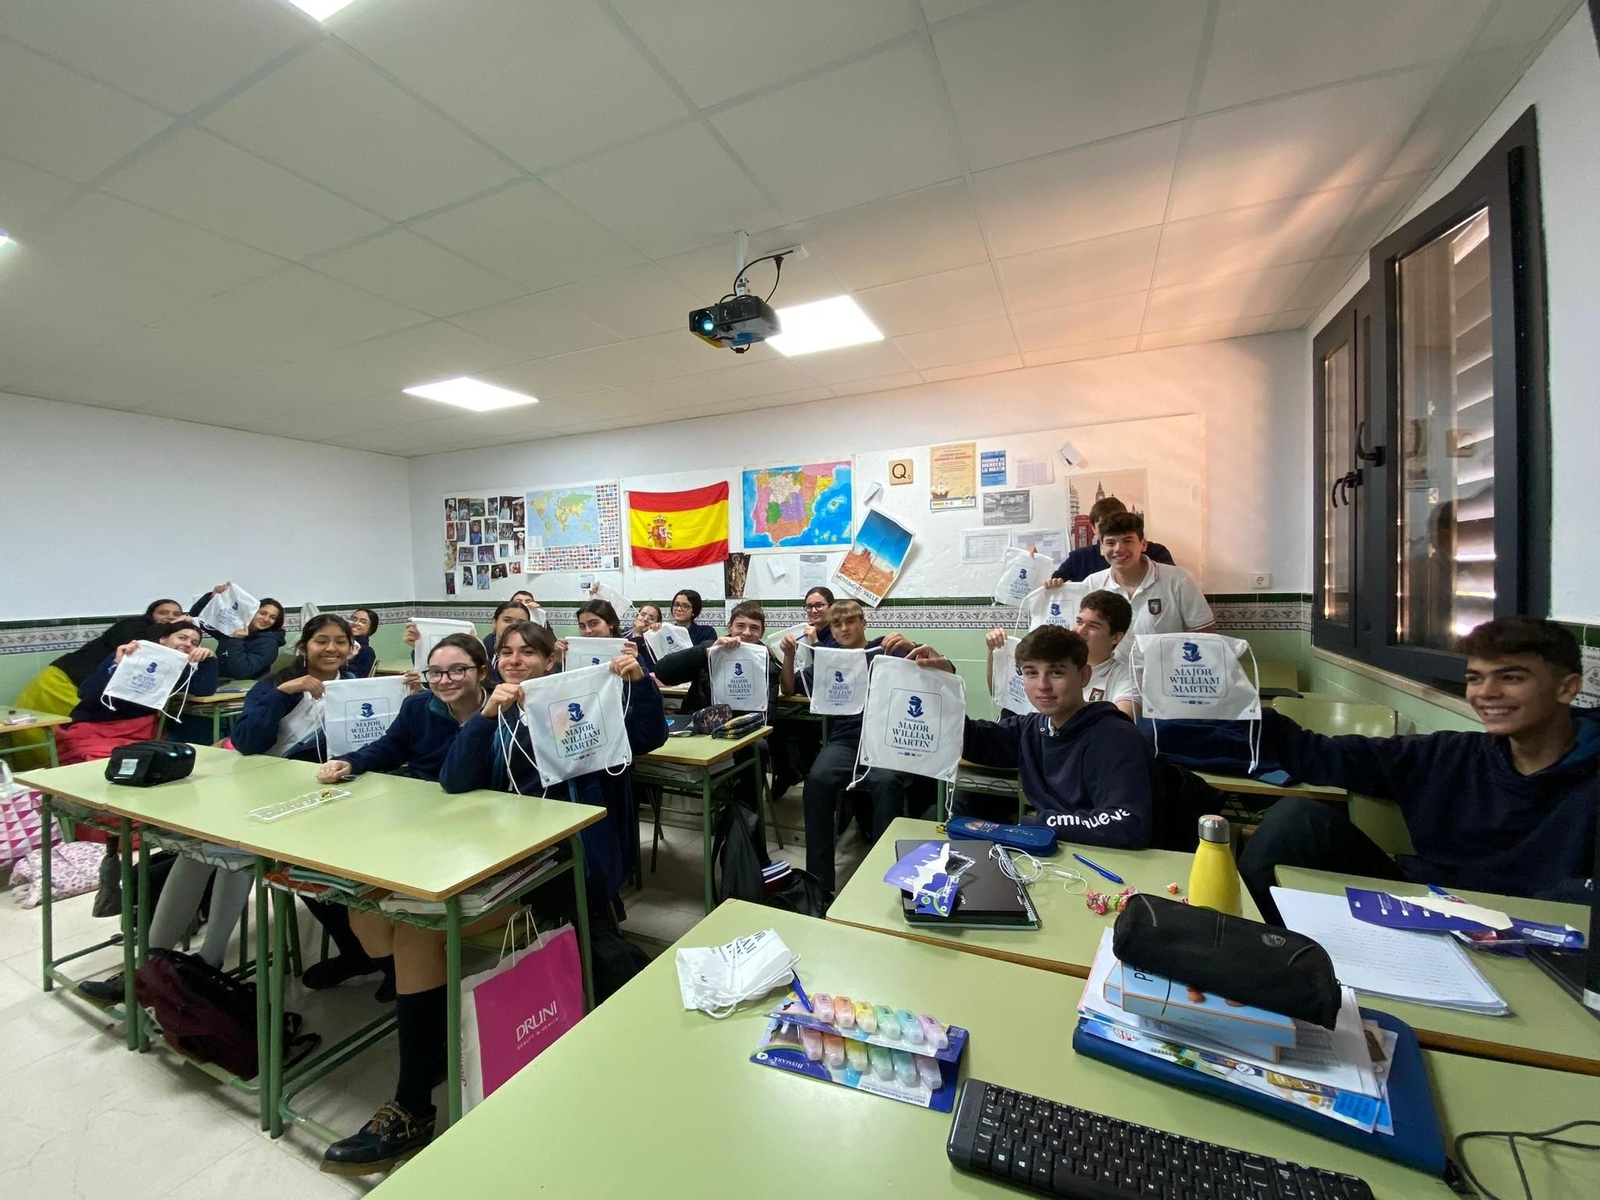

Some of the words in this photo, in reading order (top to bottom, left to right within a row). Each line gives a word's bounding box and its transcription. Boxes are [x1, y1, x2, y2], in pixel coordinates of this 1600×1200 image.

[892, 463, 906, 479] Q
[1175, 668, 1212, 676] MAJOR
[1169, 676, 1220, 685] WILLIAM
[1173, 685, 1217, 694] MARTIN
[351, 726, 386, 734] WILLIAM
[565, 723, 594, 737] MAJOR
[898, 721, 929, 733] MAJOR
[353, 731, 384, 739] MARTIN
[561, 729, 601, 746] WILLIAM
[892, 728, 934, 741] WILLIAM
[565, 738, 599, 753] MARTIN
[893, 736, 930, 748] MARTIN
[516, 1000, 558, 1042] DRUNI
